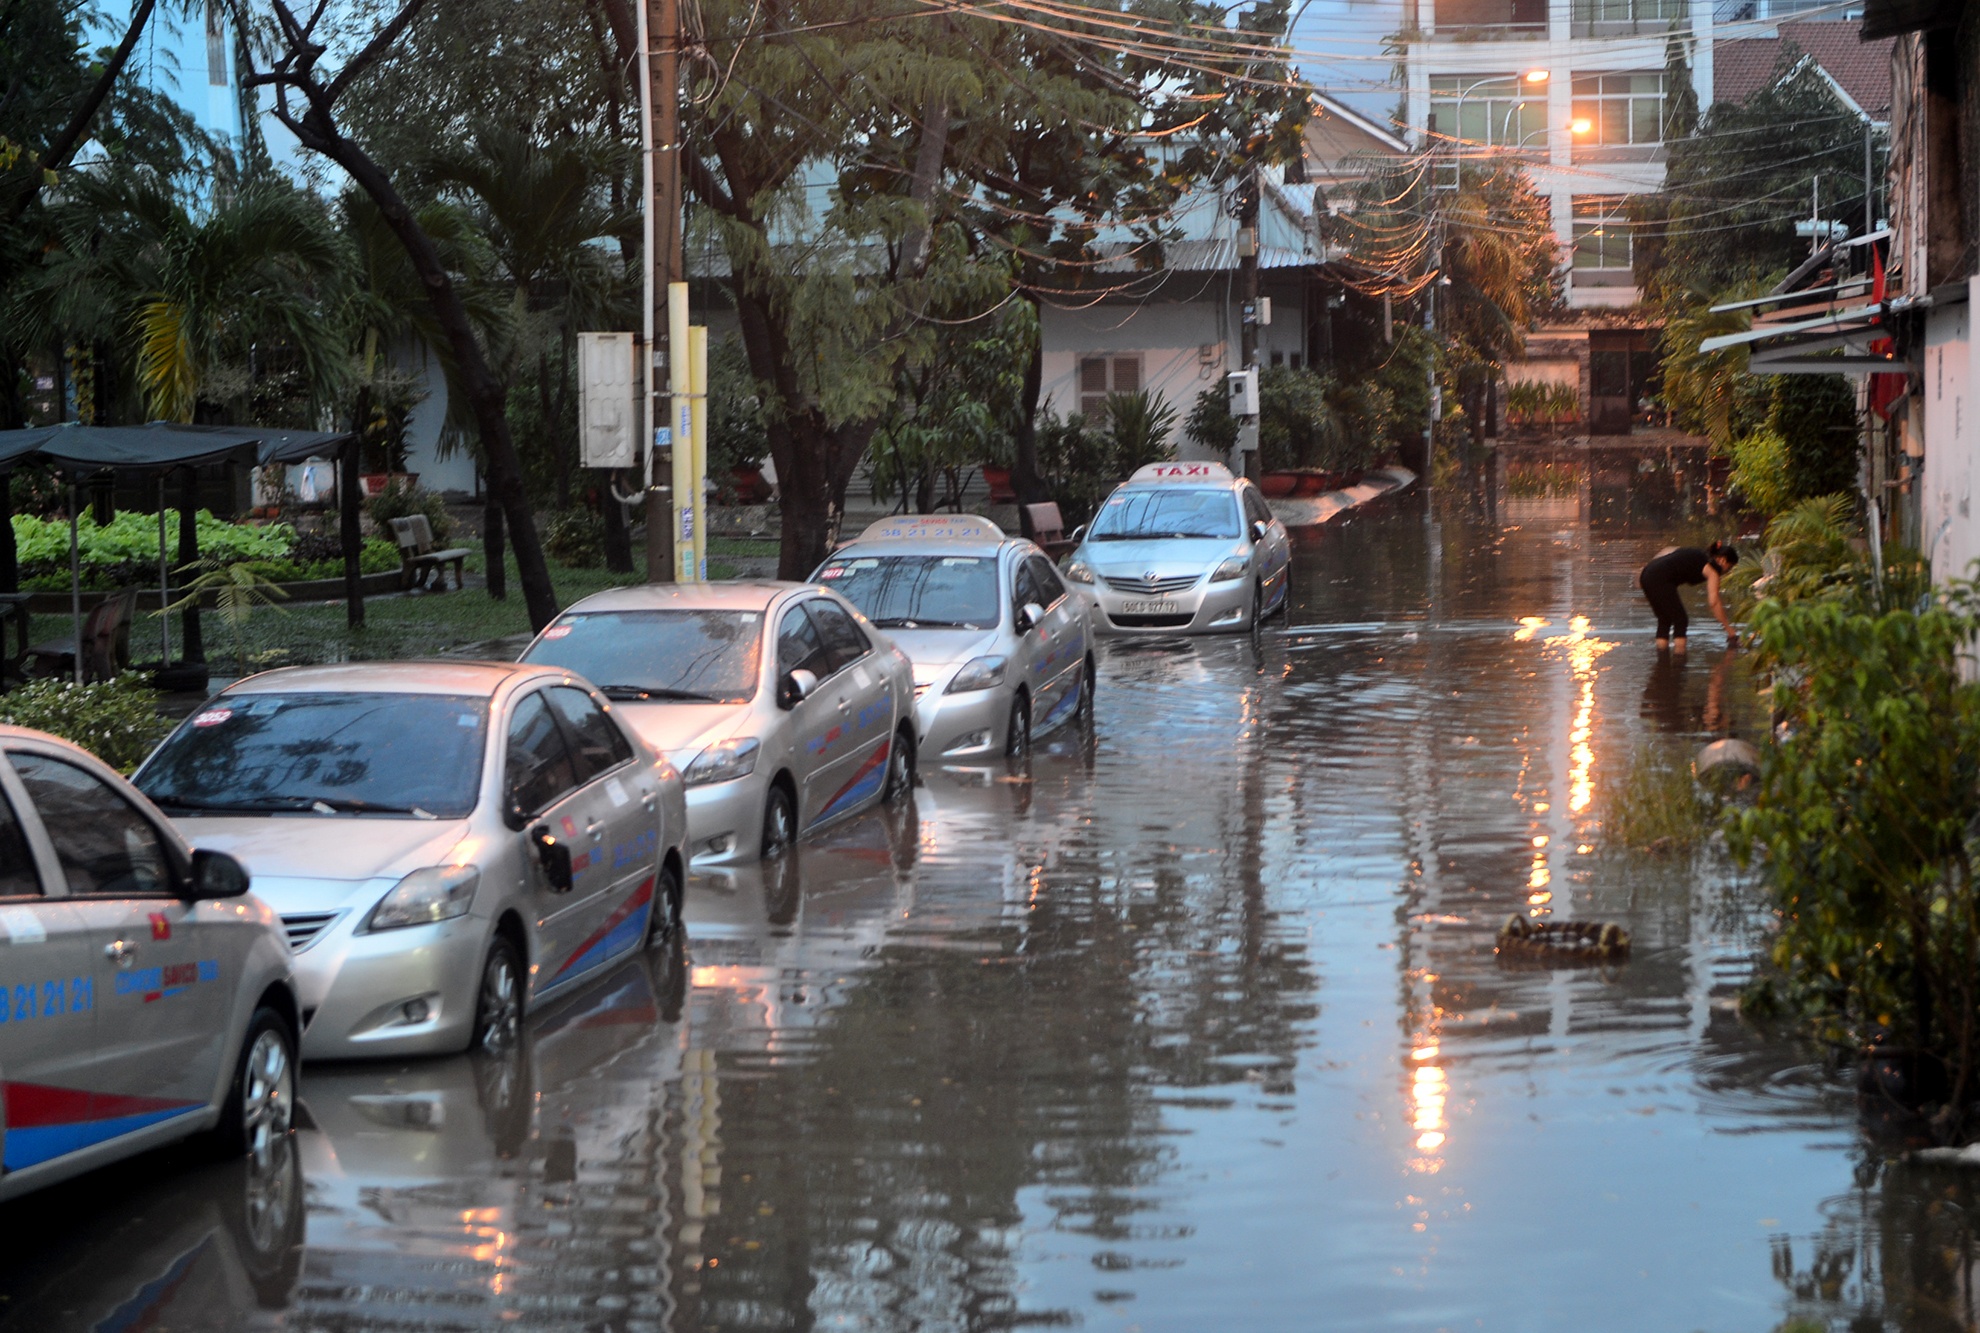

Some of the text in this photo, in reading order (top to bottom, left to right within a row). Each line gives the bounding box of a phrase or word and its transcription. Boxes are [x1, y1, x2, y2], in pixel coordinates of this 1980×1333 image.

[1152, 466, 1210, 477] TAXI
[13, 982, 37, 1020] 21
[42, 978, 66, 1017] 21
[71, 975, 94, 1012] 21
